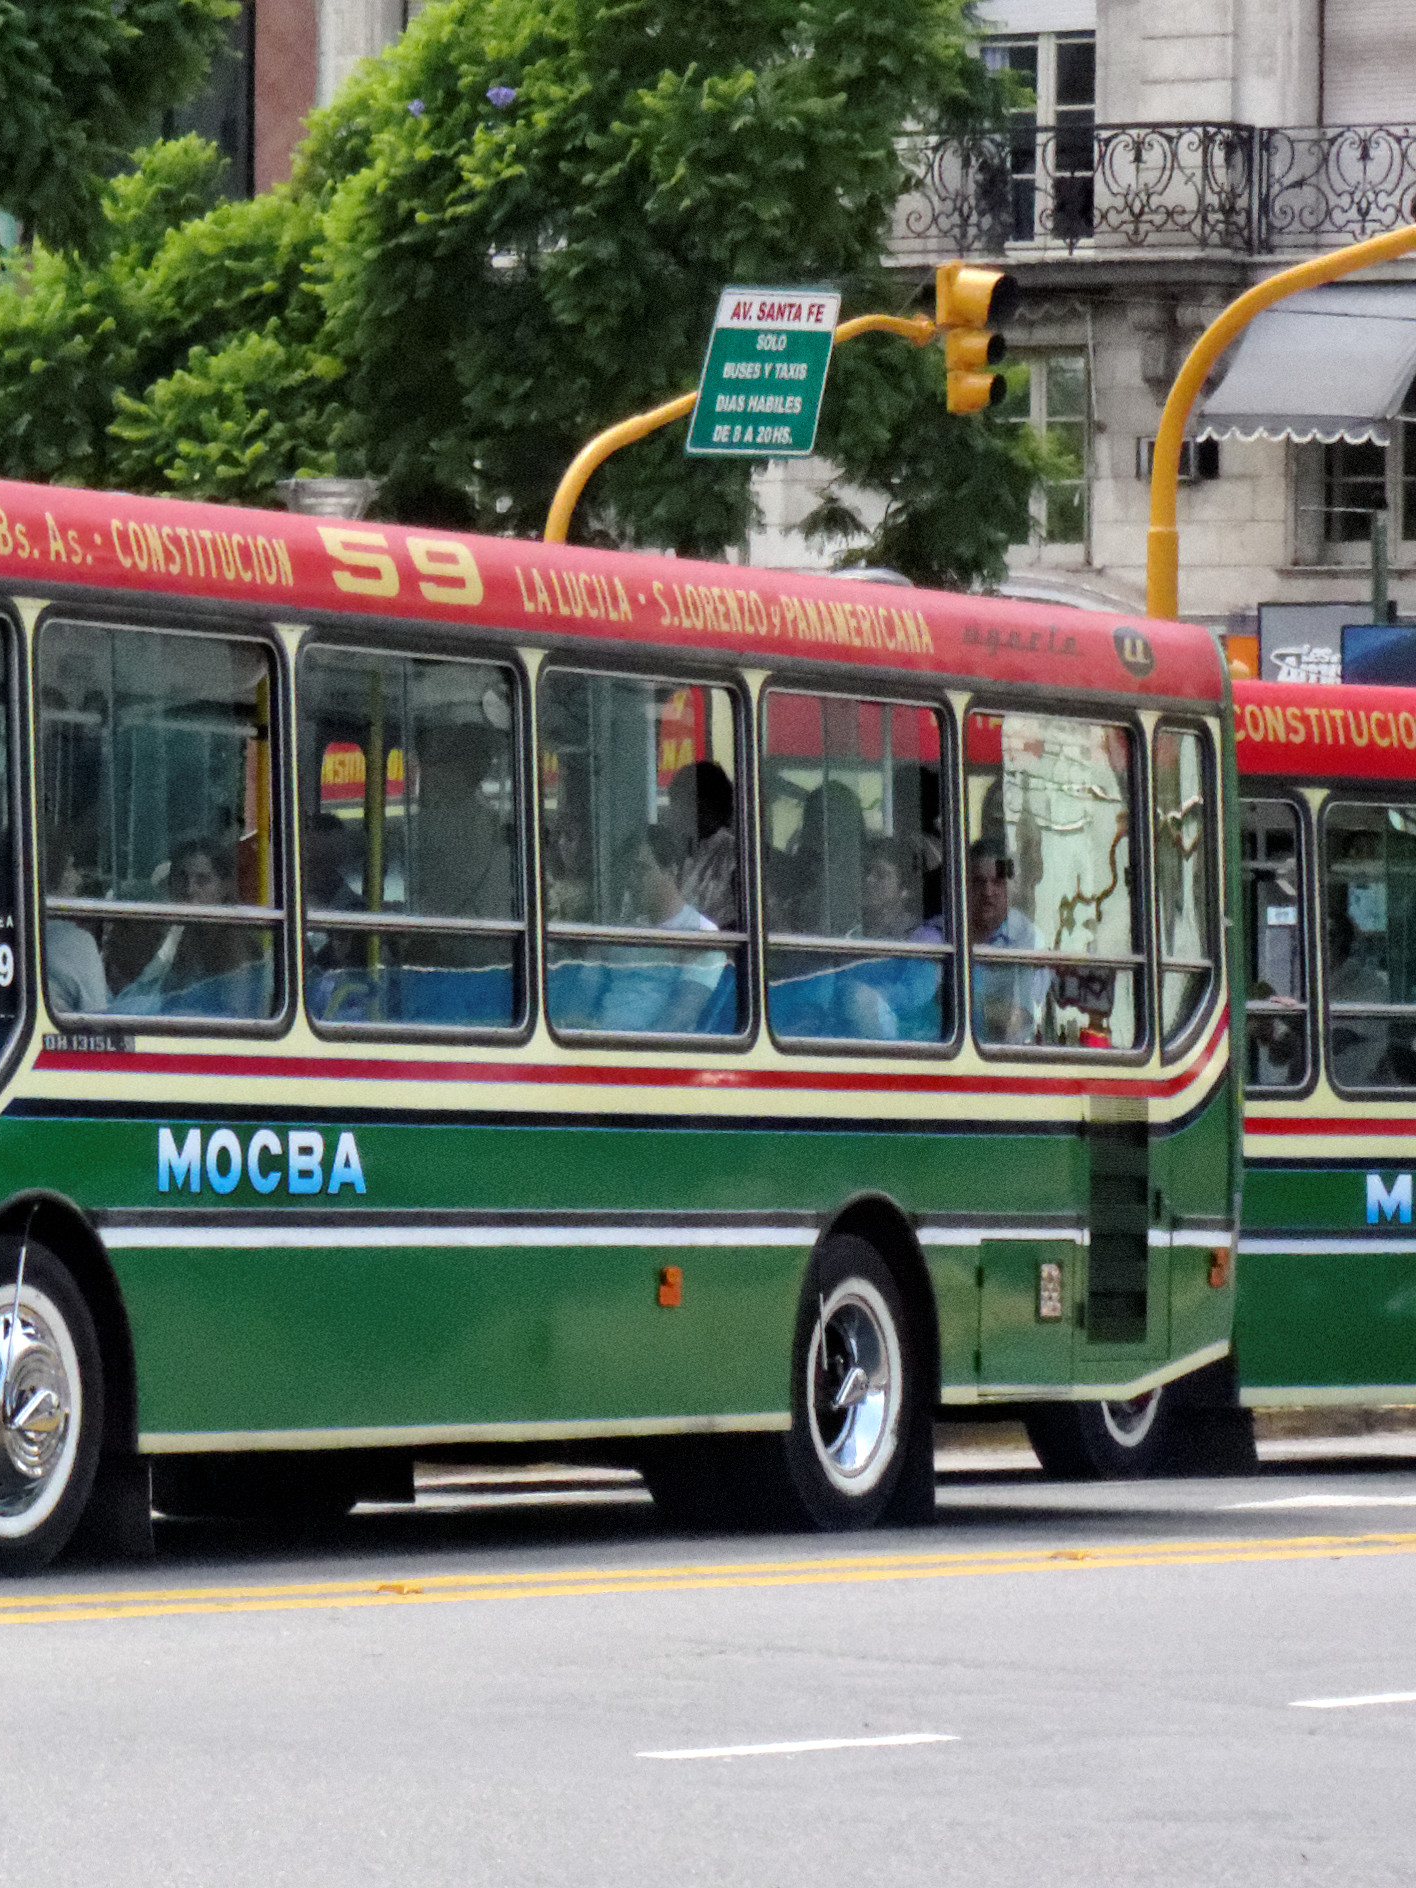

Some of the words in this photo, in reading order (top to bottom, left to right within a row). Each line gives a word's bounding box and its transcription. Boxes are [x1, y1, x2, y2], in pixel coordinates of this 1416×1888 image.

[730, 301, 753, 321] AV.
[756, 302, 803, 322] SANTA
[806, 303, 826, 323] FE
[755, 333, 788, 352] SOLO
[722, 361, 762, 380] BUSES
[763, 362, 774, 379] Y
[774, 363, 808, 380] TAXIS
[715, 393, 746, 413] DIAS
[746, 394, 803, 415] HABILES
[712, 424, 732, 443] DE
[743, 425, 754, 443] A
[110, 518, 294, 588] CONSTITUCION
[316, 526, 485, 606] 59
[514, 565, 553, 615] LA
[548, 568, 633, 622] LUCILA
[779, 594, 934, 654] PANAMERICANA
[158, 1127, 367, 1195] MOCBA
